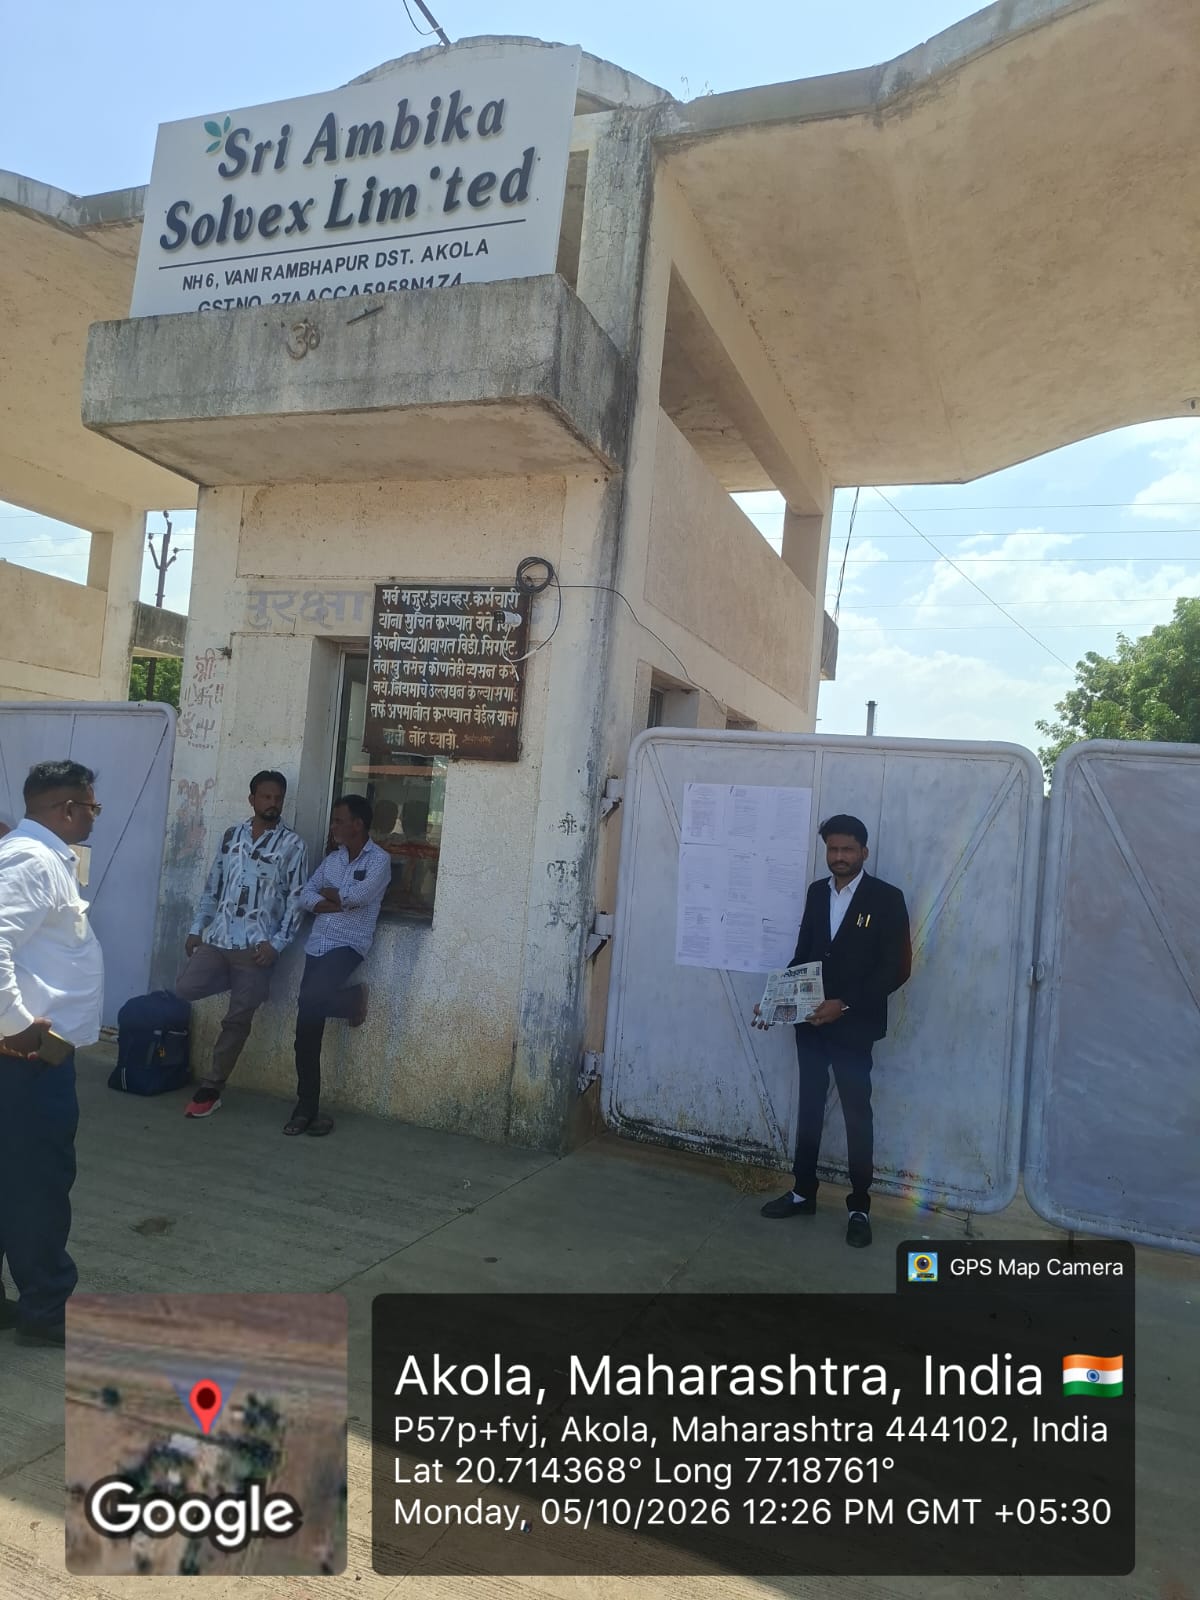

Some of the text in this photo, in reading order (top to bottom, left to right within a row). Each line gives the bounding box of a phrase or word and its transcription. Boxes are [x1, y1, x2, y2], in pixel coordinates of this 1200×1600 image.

[218, 89, 506, 179] Sri Ambika
[159, 145, 537, 250] Solvex Limted
[225, 267, 258, 285] VANI
[260, 253, 369, 282] RAMBHAPUR
[374, 248, 414, 268] DST.
[420, 238, 489, 263] AKOLA
